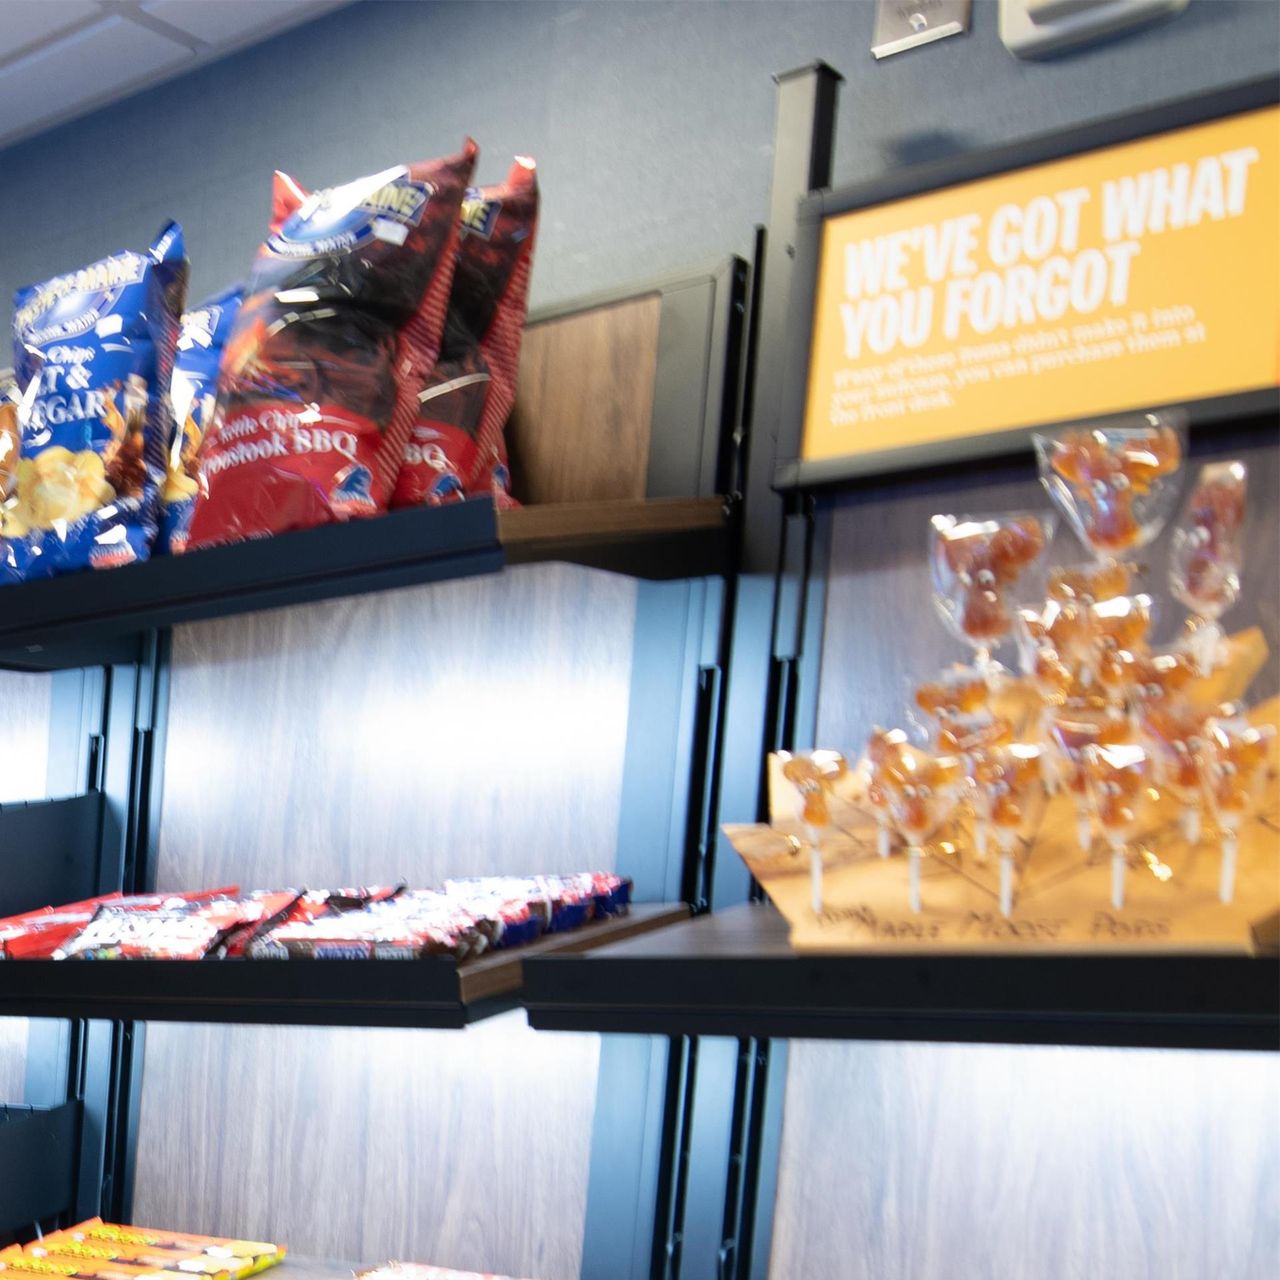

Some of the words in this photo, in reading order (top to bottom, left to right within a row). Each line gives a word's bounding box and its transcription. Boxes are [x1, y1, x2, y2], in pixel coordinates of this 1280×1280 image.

[843, 213, 982, 299] WE'VE
[988, 187, 1091, 267] GOT
[1102, 147, 1259, 241] WHAT
[840, 285, 936, 360] YOU
[943, 243, 1141, 340] FORGOT
[201, 431, 289, 475] roostook
[293, 428, 359, 463] BBQ
[403, 442, 447, 472] BQ
